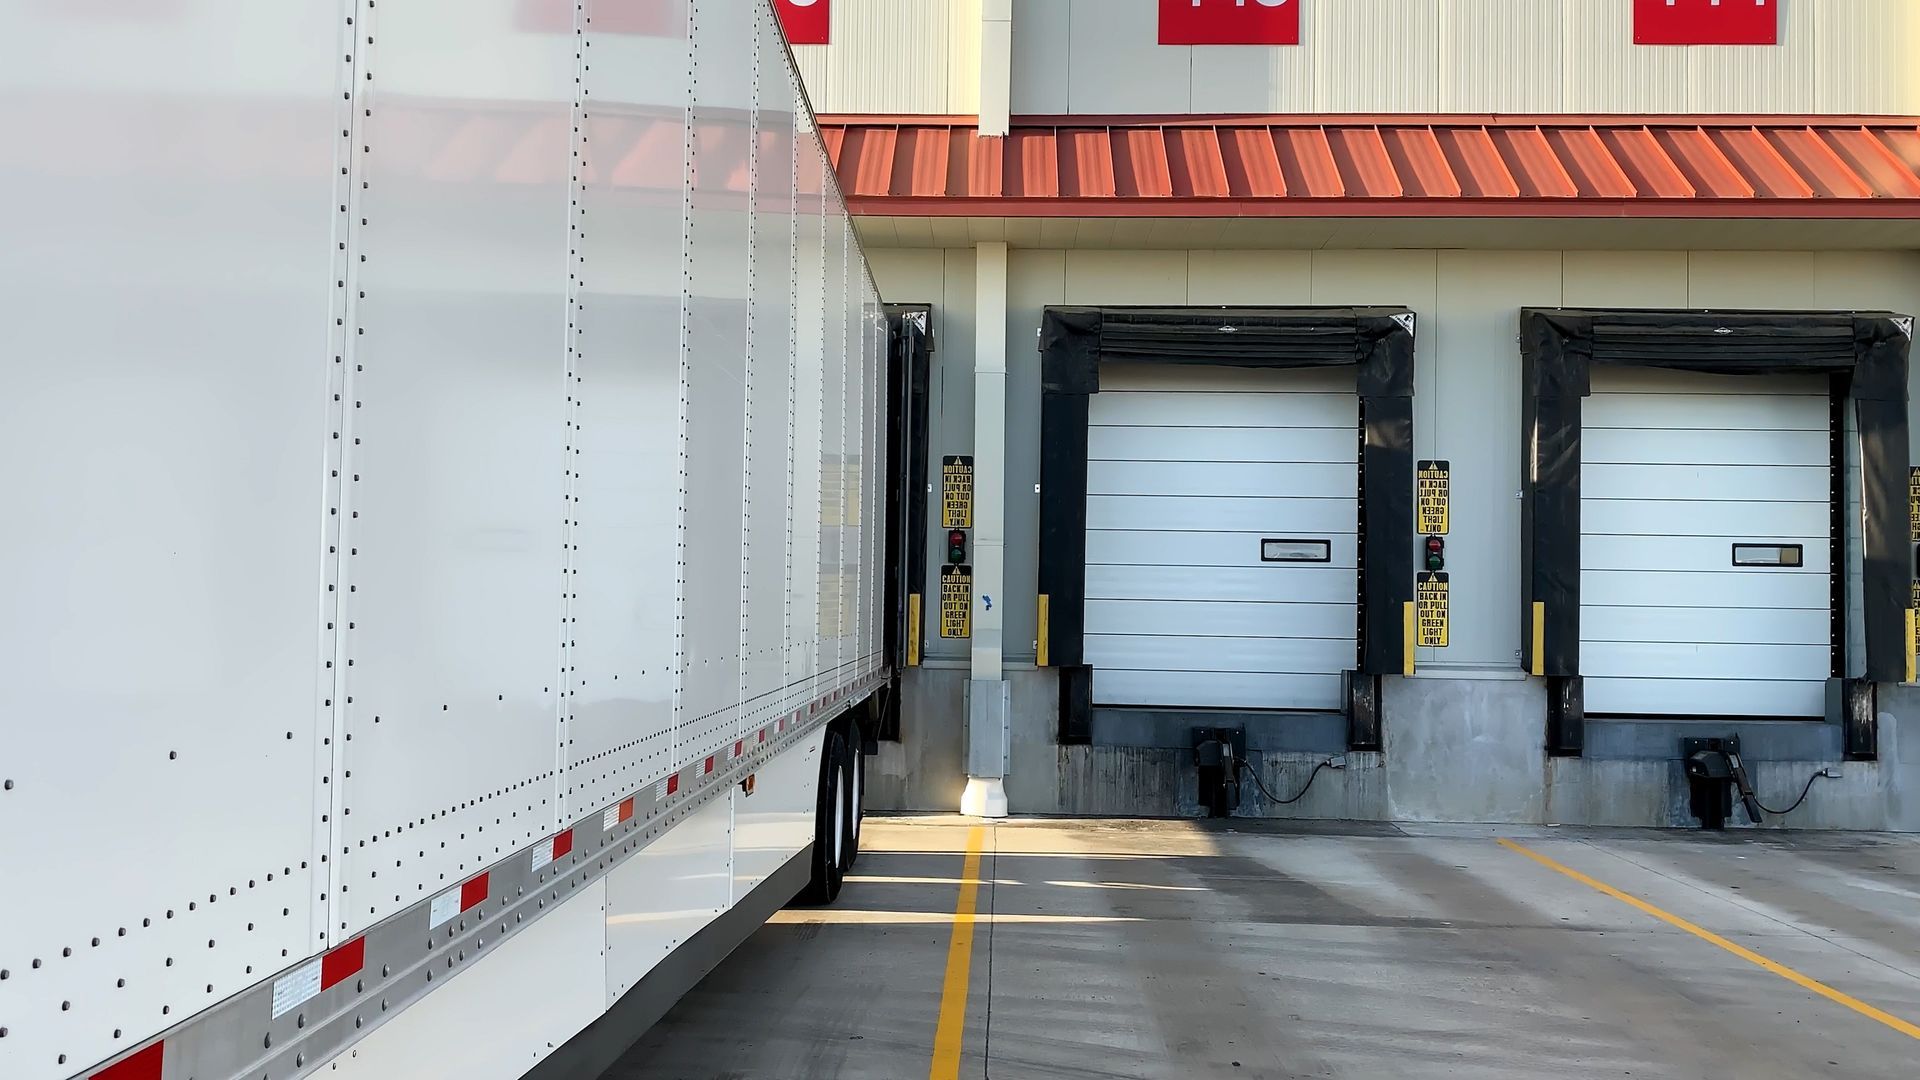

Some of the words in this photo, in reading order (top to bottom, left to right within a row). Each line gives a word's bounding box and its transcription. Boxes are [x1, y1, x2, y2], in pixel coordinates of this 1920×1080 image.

[942, 574, 970, 584] CAUTION
[944, 584, 961, 592] BACK
[962, 584, 969, 592] IN
[1418, 582, 1448, 591] CAUTION
[954, 594, 970, 602] PULL
[1420, 592, 1438, 600] BACK
[1440, 592, 1447, 600] IN
[944, 602, 956, 610] OUT
[960, 602, 968, 610] ON
[1418, 601, 1428, 609] OR
[1430, 601, 1447, 610] PULL
[946, 610, 966, 618] GREEN
[1420, 610, 1434, 618] OUT
[1436, 610, 1446, 618] ON
[946, 620, 965, 628] LIGHT
[1422, 618, 1444, 627] GREEN
[1422, 628, 1442, 636] LIGHT
